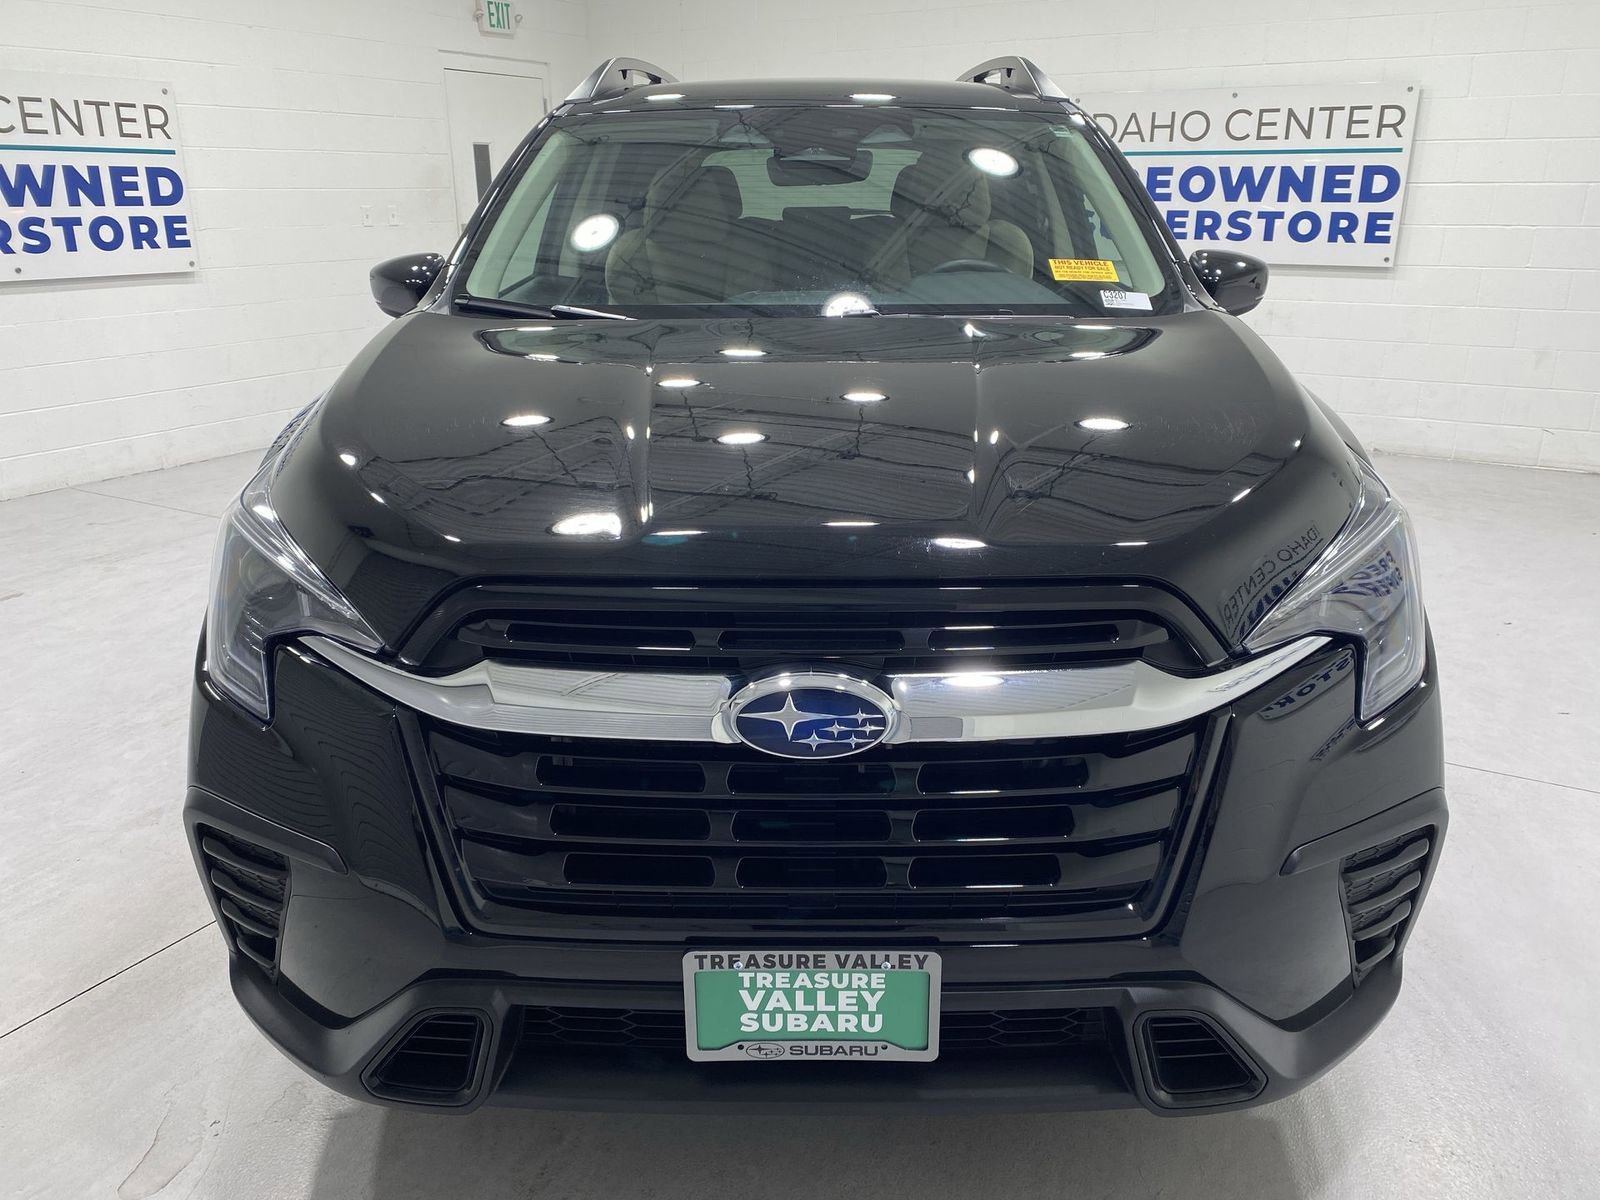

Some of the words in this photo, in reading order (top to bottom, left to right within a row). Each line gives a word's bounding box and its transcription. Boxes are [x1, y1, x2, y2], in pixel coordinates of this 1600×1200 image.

[487, 1, 510, 30] EXIT
[1225, 105, 1406, 141] CENTER
[694, 954, 826, 970] TREASURE
[835, 954, 929, 970] VALLEY
[738, 972, 886, 989] TREASURE
[739, 990, 885, 1012] VALLEY
[740, 1013, 883, 1033] SUBARU
[789, 1045, 878, 1056] SUBARU
